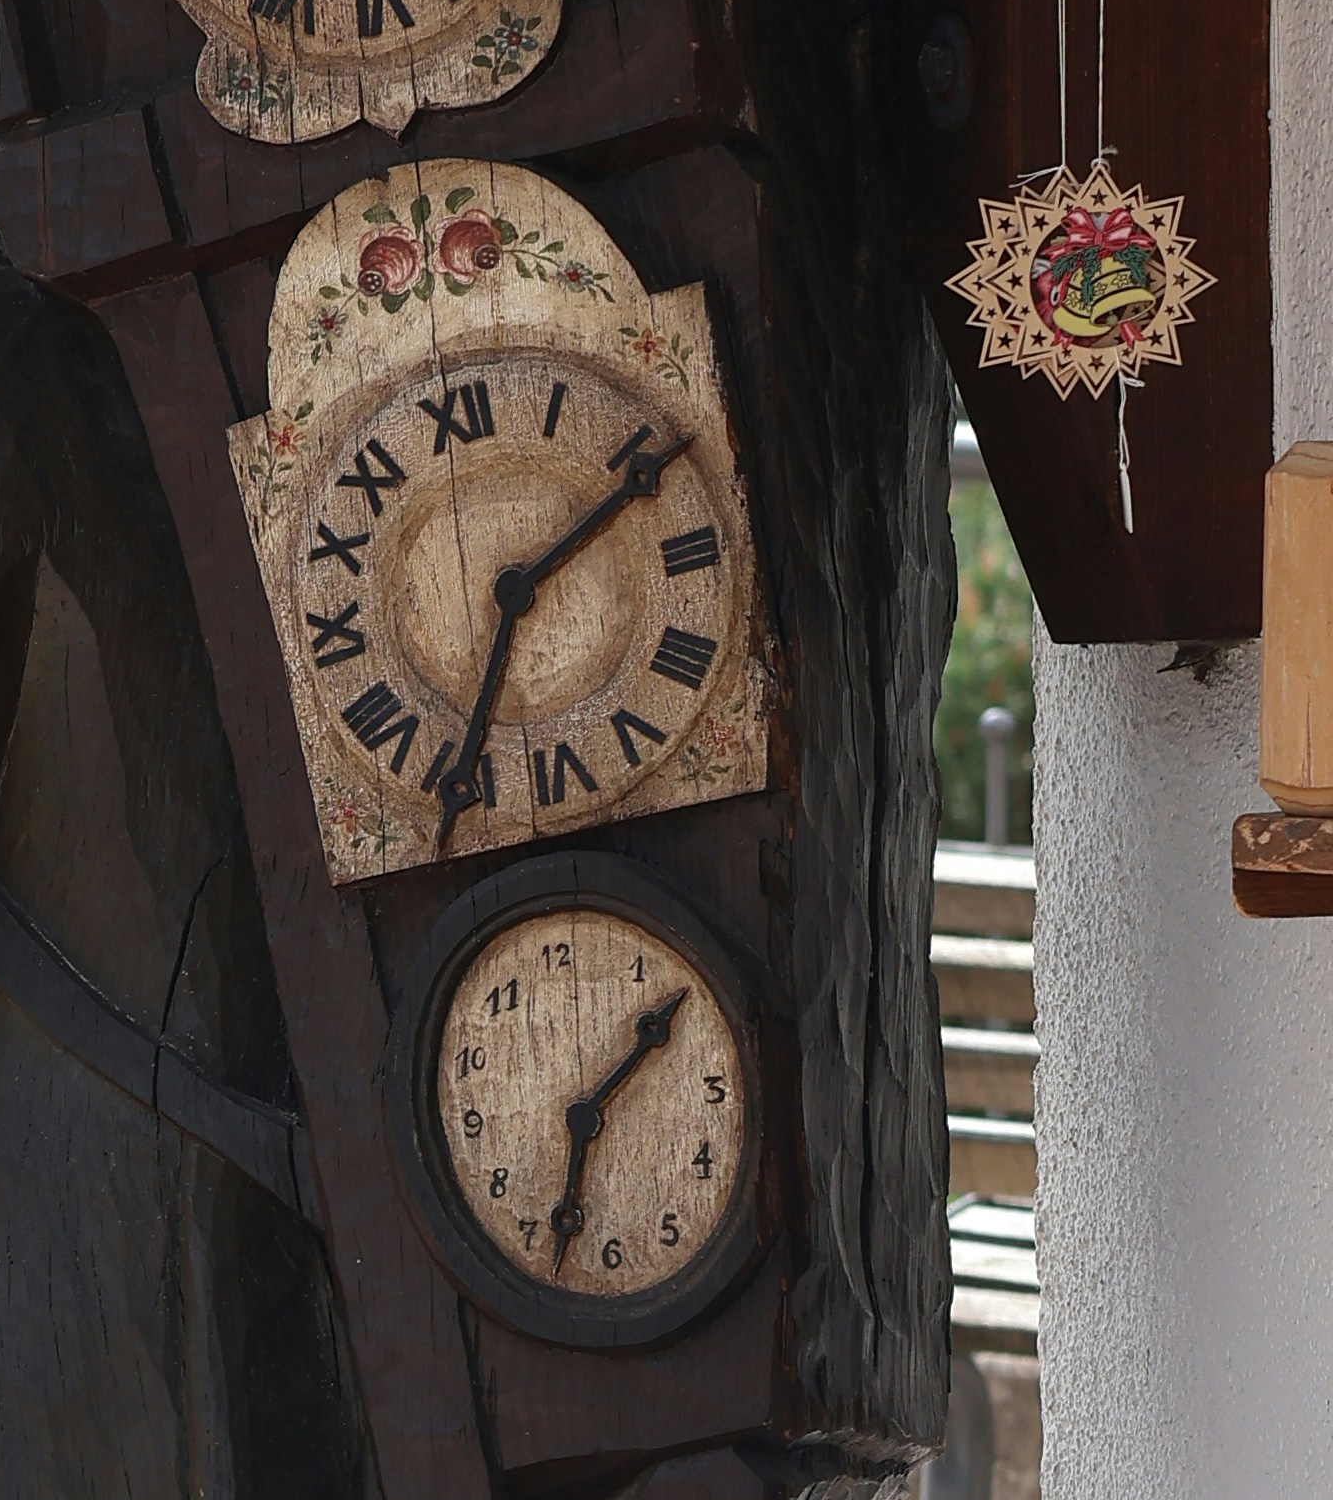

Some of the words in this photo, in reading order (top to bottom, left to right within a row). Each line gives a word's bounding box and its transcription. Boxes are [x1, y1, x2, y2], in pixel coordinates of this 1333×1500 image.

[417, 380, 494, 455] XII
[544, 382, 567, 438] I
[336, 438, 406, 517] XI
[310, 523, 369, 576] X
[662, 526, 721, 577] III
[307, 602, 366, 669] IX
[650, 627, 718, 690] IIII
[341, 681, 420, 775] VIII
[610, 709, 667, 765] V
[534, 744, 598, 805] VI
[542, 942, 572, 969] 12
[628, 955, 645, 982] 1
[486, 979, 520, 1017] 11
[454, 1046, 486, 1079] 10
[703, 1076, 726, 1104] 3
[463, 1110, 483, 1138] 9
[692, 1141, 713, 1179] 4
[489, 1167, 508, 1198] 8
[519, 1219, 538, 1251] 7
[661, 1213, 680, 1247] 5
[602, 1239, 622, 1270] 6
